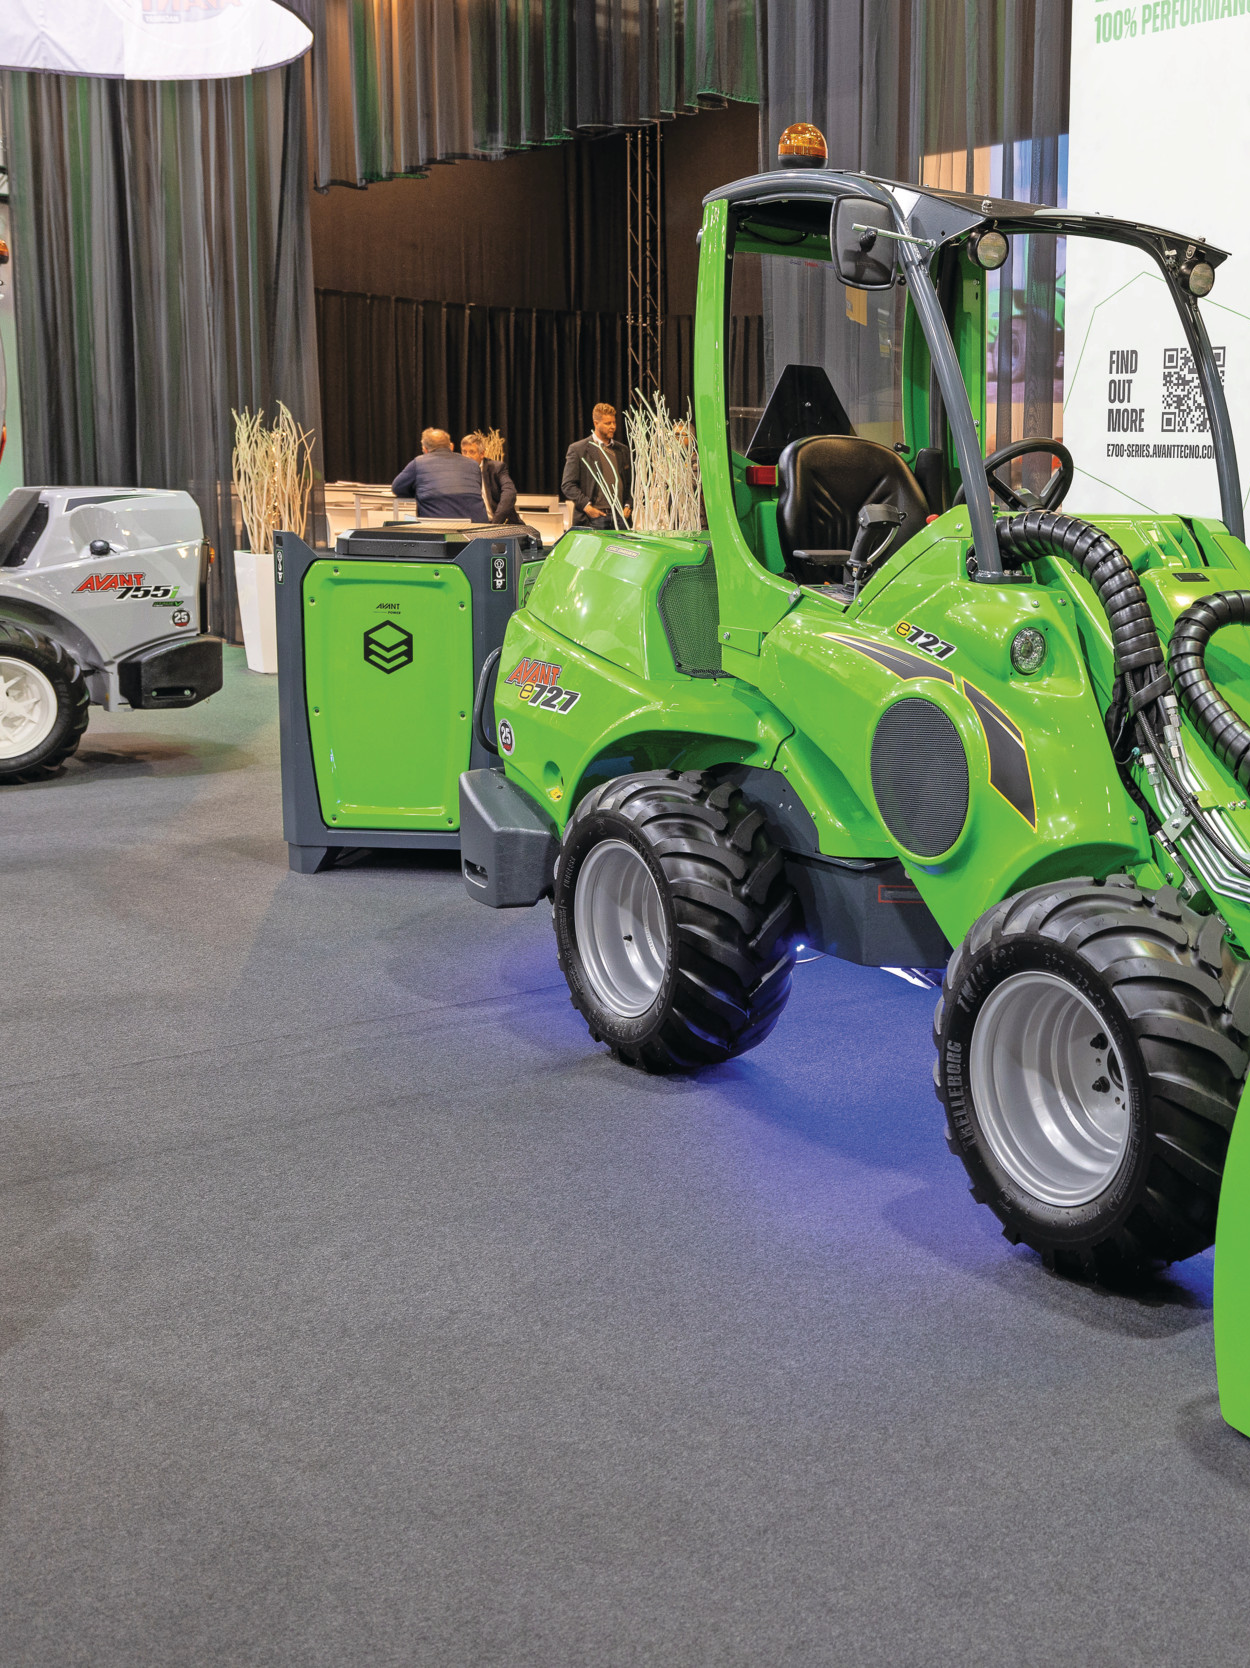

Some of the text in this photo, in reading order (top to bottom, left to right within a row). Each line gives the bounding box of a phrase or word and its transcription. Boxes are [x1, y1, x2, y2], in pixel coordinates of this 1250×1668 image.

[1094, 7, 1138, 44] 100%
[1109, 350, 1139, 375] FIND
[1108, 379, 1133, 403] OUT
[1107, 408, 1145, 433] MORE
[73, 572, 145, 593] AVANT
[116, 586, 181, 600] 755i
[174, 612, 189, 624] 25
[896, 621, 957, 661] e727
[505, 657, 562, 688] AVANT
[518, 681, 581, 714] e727
[501, 726, 511, 744] 25
[946, 1040, 978, 1151] TRELLEBORG
